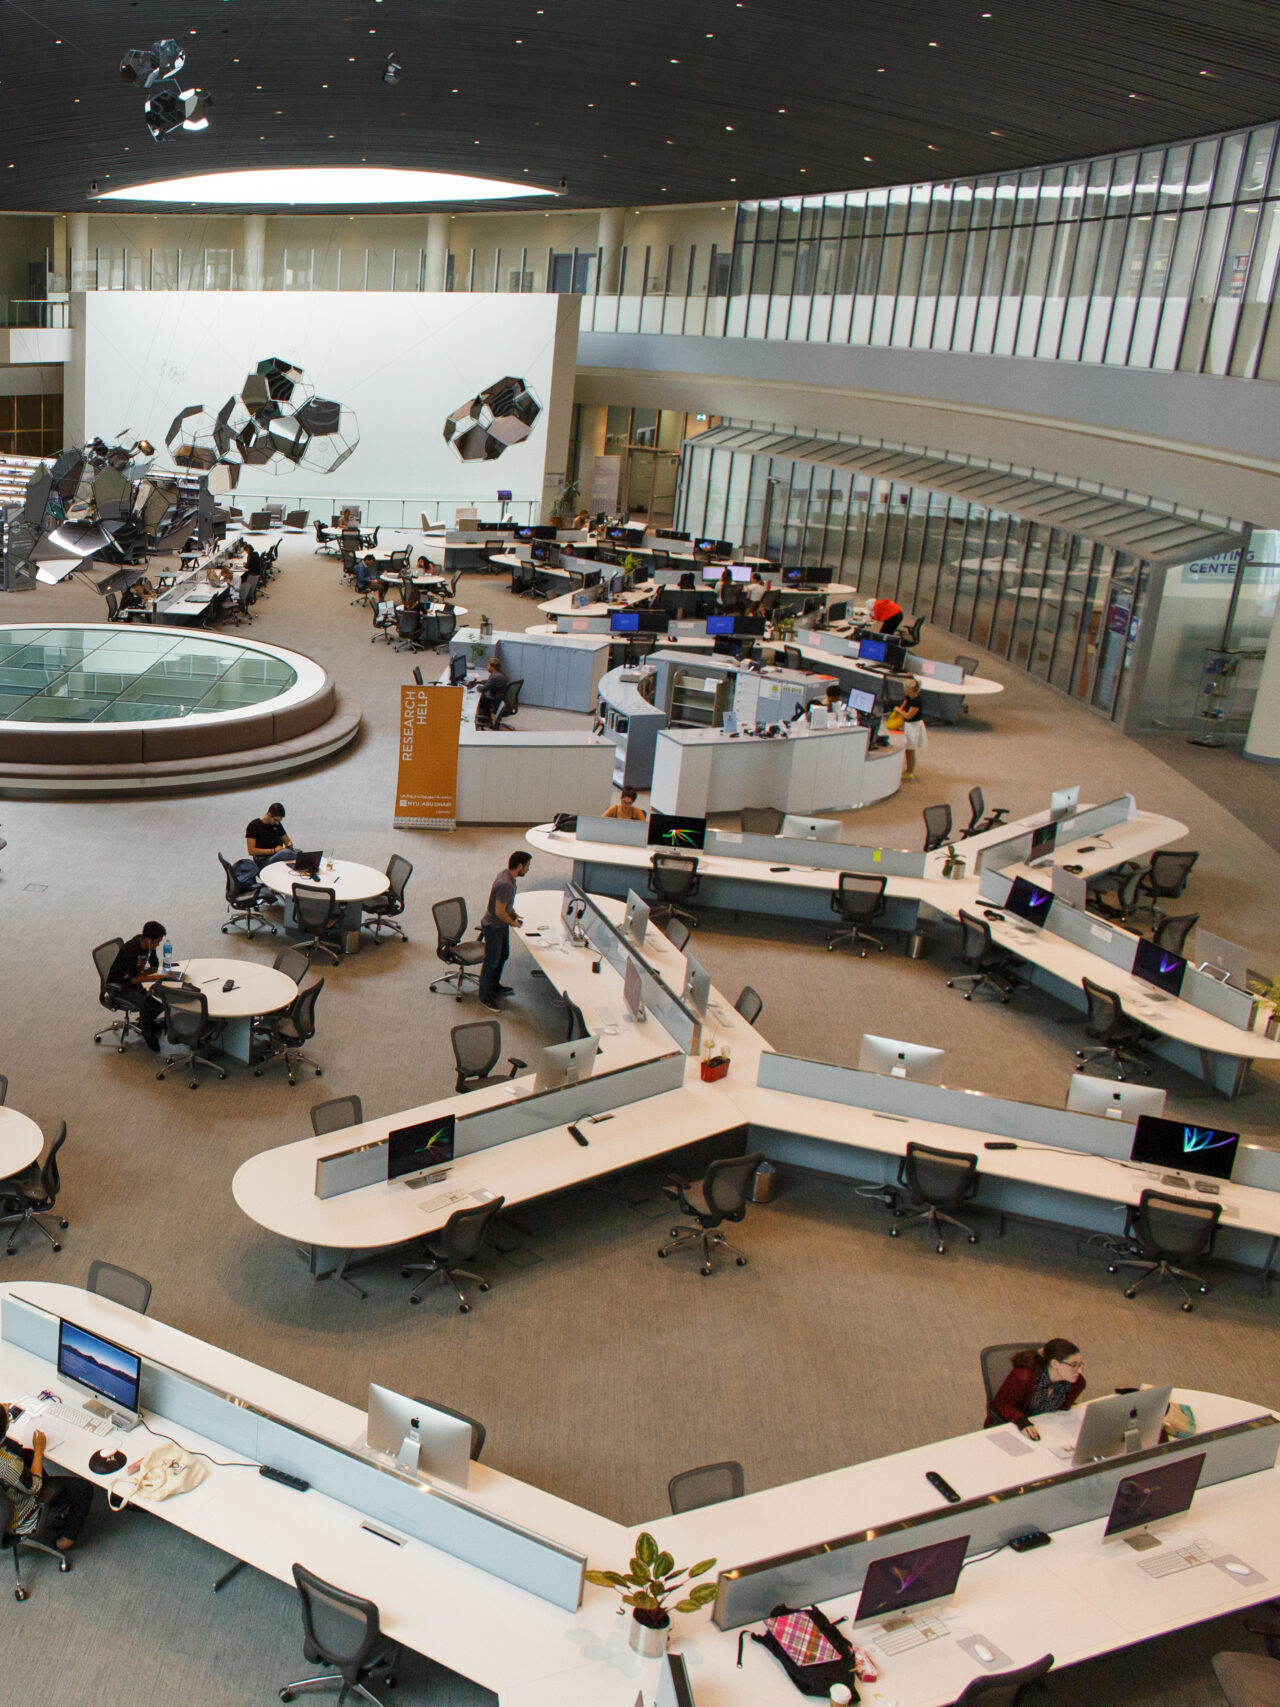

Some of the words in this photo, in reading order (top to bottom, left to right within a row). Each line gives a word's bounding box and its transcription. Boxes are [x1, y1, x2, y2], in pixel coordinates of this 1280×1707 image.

[1207, 550, 1255, 562] RITING
[1189, 563, 1236, 574] CENTE
[416, 691, 428, 725] HELP
[402, 691, 416, 761] RESEARCH
